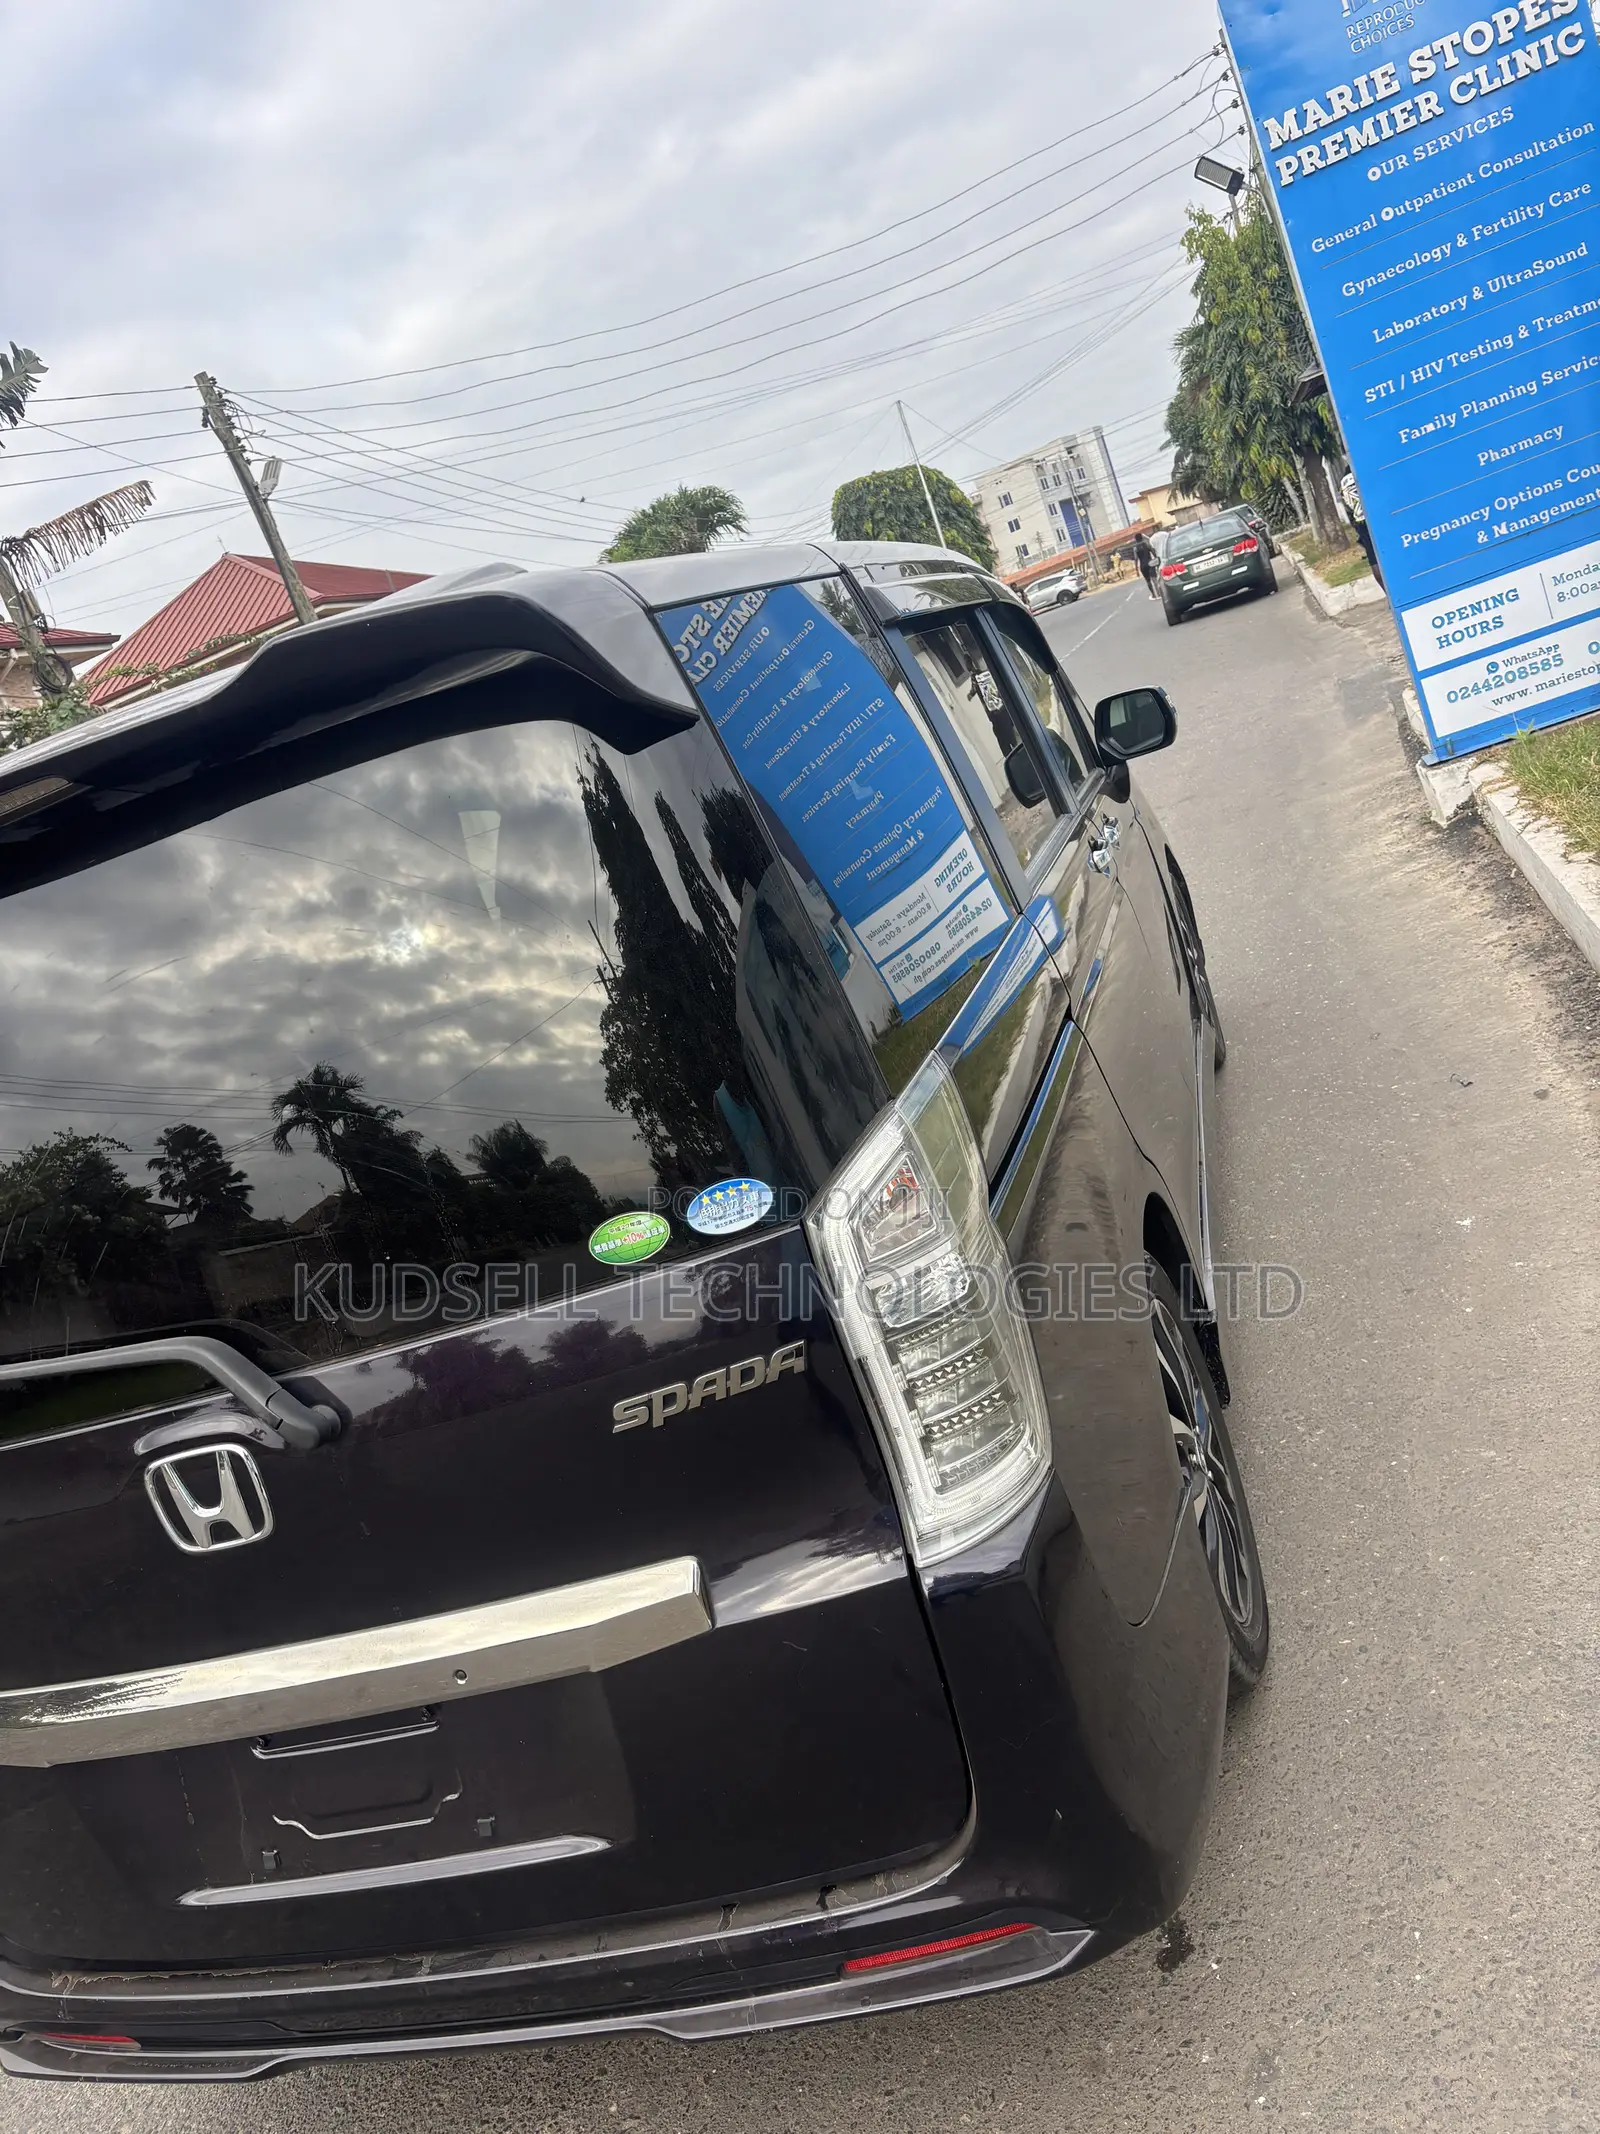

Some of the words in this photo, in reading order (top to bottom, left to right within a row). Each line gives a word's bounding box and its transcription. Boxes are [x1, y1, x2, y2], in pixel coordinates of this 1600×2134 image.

[1350, 13, 1415, 53] CHOICES
[1263, 61, 1401, 151] MARIE
[1275, 90, 1444, 187] PREMIER
[1449, 21, 1586, 105] CLINIC
[1367, 154, 1410, 181] OUR
[1412, 105, 1515, 162] SERVICES
[1311, 214, 1378, 253] General
[1380, 172, 1476, 222] Outpatient
[1478, 121, 1596, 179] Consultation
[1341, 242, 1452, 298] Gynaecology
[1456, 232, 1469, 248] &
[1471, 200, 1546, 242] Fertility
[1548, 182, 1592, 208] Care
[1372, 294, 1467, 344] Laboratory
[1472, 285, 1484, 301] &
[1487, 242, 1589, 294] UltraSound
[1364, 379, 1396, 404] STI
[1400, 373, 1405, 390] /
[1410, 358, 1444, 384] HIV
[1446, 333, 1514, 368] Testing
[1518, 324, 1530, 339] &
[1398, 412, 1457, 444] Family
[1460, 379, 1538, 418] Planning
[1541, 355, 1600, 386] Servic
[1477, 425, 1564, 466] Pharmacy
[1401, 505, 1490, 548] Pregnancy
[1494, 478, 1563, 511] Options
[1477, 530, 1489, 544] &
[1431, 587, 1520, 629] OPENING
[1552, 562, 1600, 587] Monda
[1556, 581, 1600, 603] 8:00a
[1436, 615, 1504, 650] HOURS
[1501, 643, 1560, 669] WhatsApp
[1446, 653, 1564, 704] 0244208585
[612, 1339, 806, 1434] SPADA
